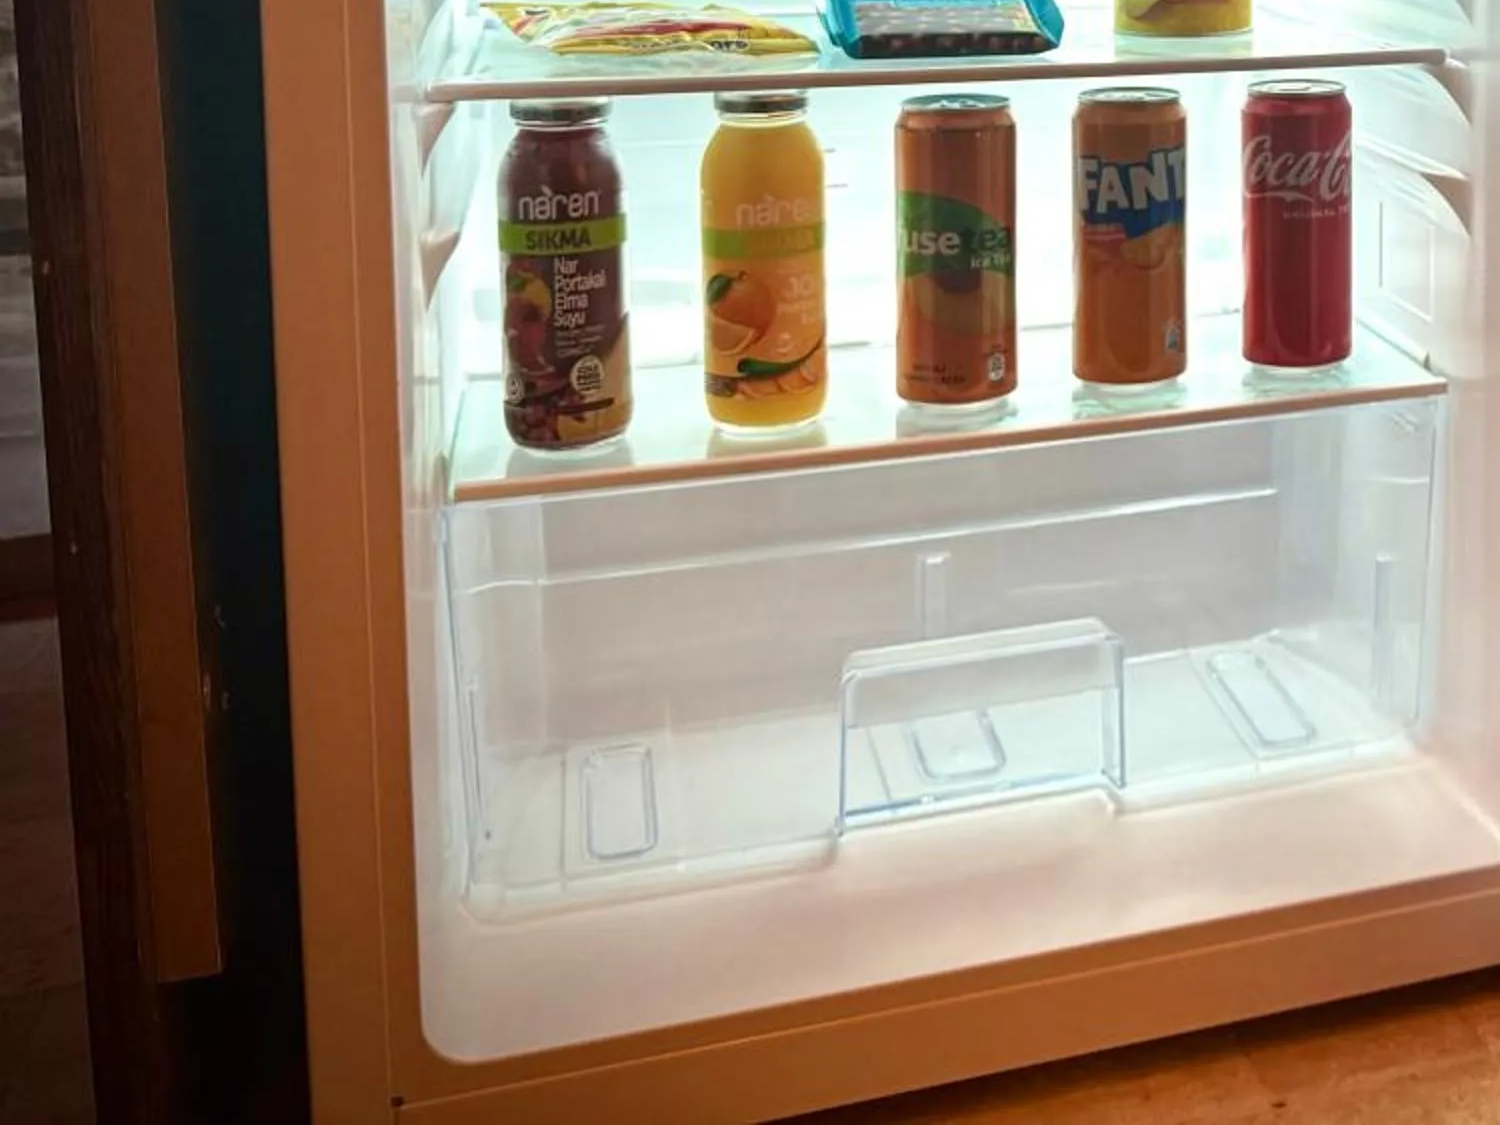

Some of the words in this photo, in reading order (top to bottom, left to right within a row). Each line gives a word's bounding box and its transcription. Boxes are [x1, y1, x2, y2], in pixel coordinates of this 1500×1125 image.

[1080, 147, 1186, 213] FANT
[905, 230, 960, 255] use
[554, 256, 579, 274] Nar
